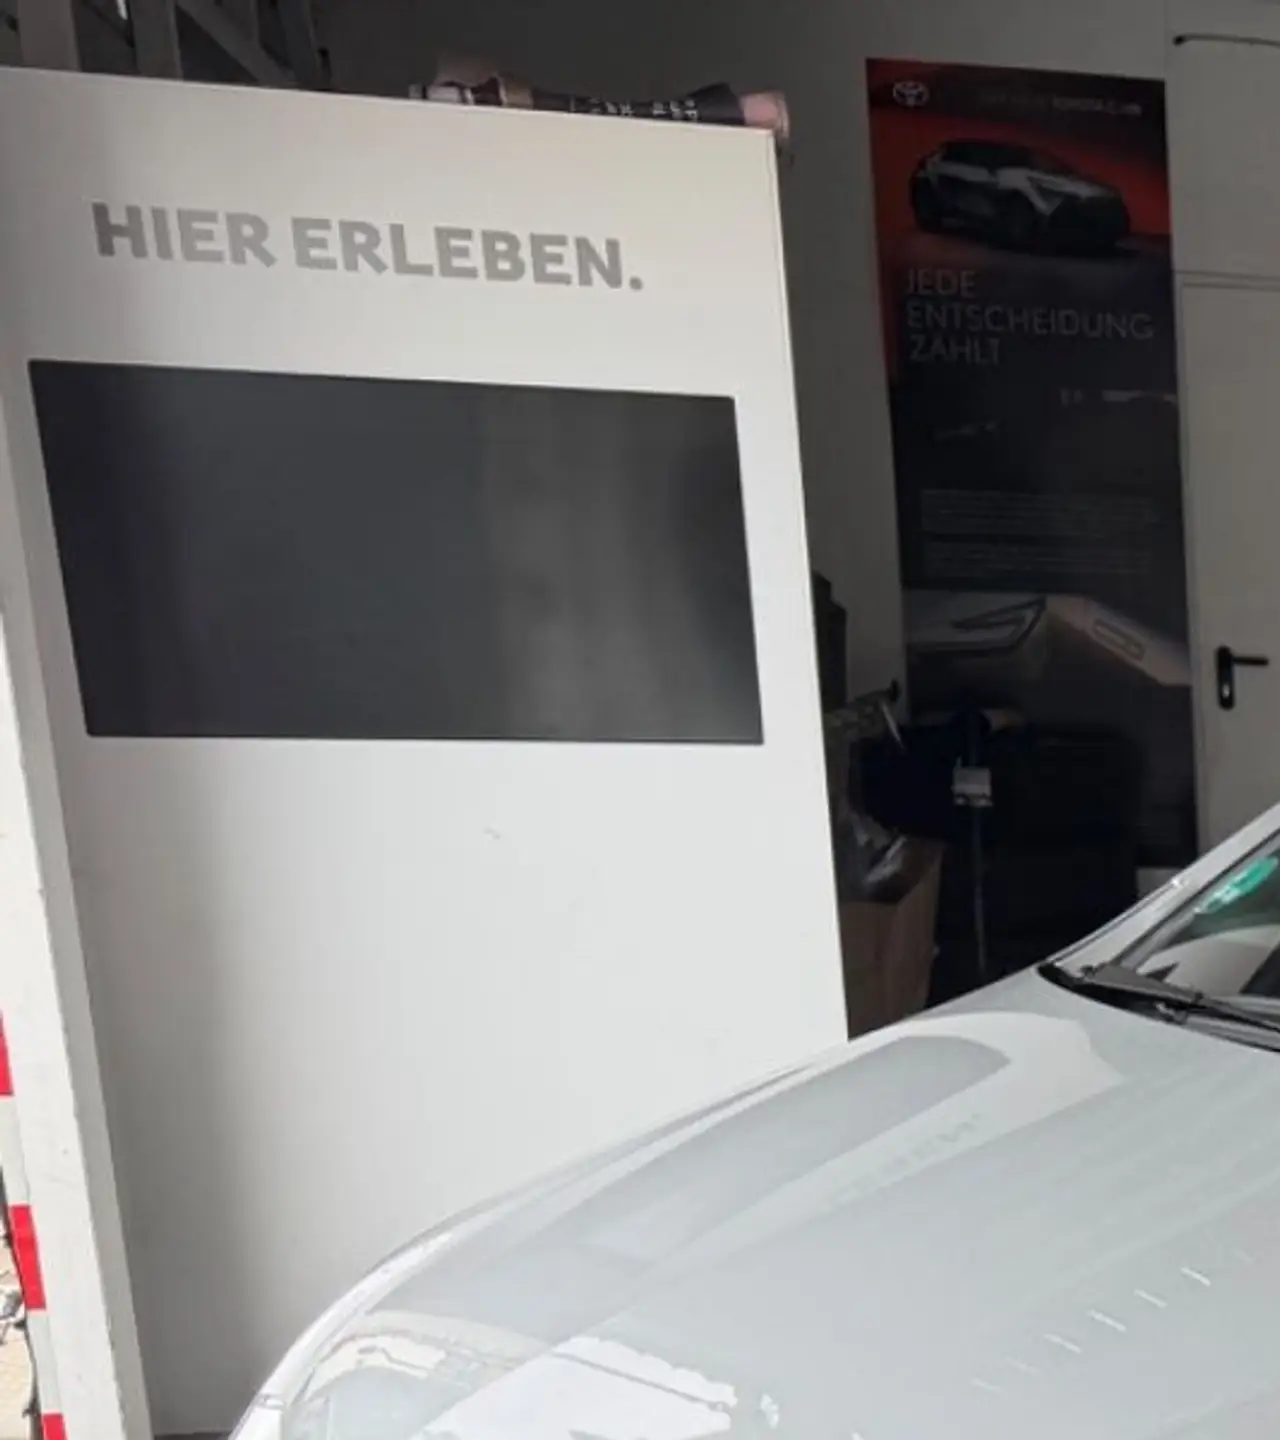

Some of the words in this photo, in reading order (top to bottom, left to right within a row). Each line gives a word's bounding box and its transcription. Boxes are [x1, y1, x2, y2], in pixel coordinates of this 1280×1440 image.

[91, 202, 277, 268] HIER
[291, 215, 644, 291] ERLEBEN.
[905, 267, 978, 300] JEDE
[906, 300, 1155, 340] ENTSCHEIDUNG
